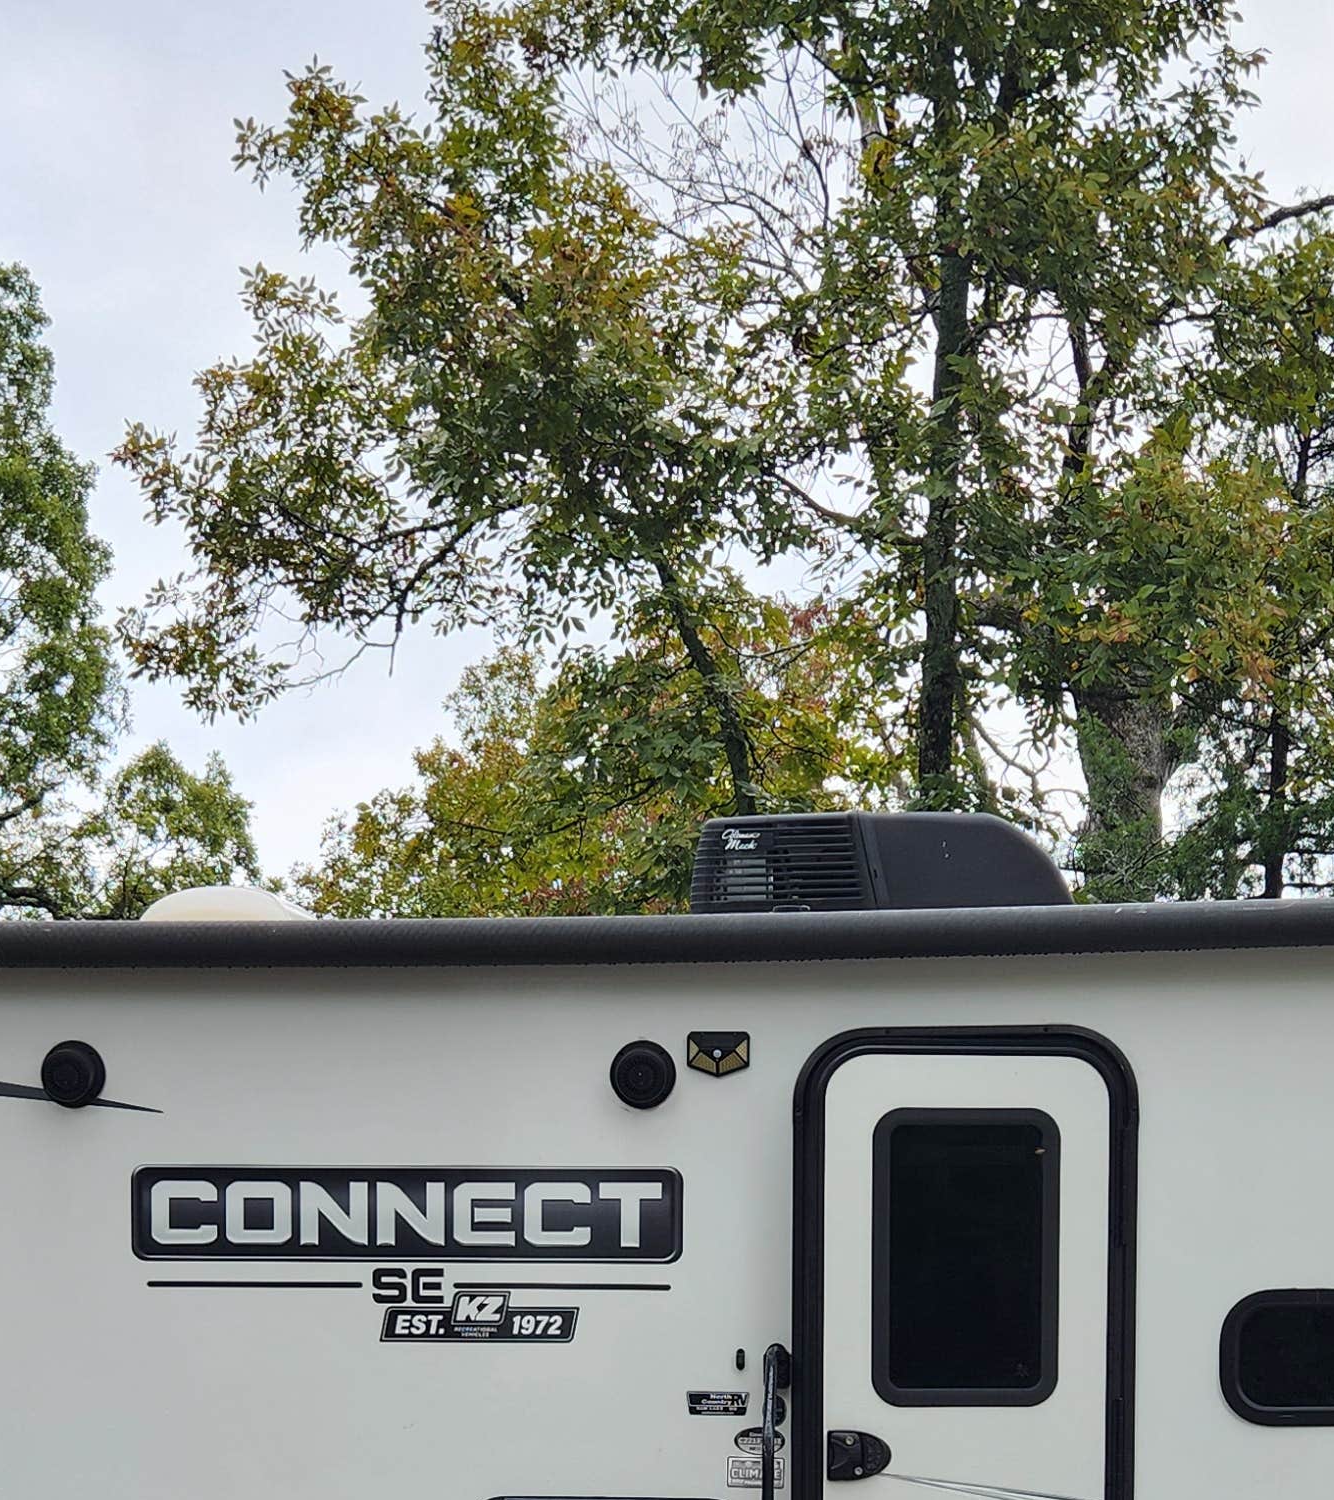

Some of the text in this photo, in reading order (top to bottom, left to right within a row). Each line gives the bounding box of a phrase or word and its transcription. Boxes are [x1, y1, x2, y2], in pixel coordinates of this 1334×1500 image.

[150, 1180, 663, 1248] CONNECT
[372, 1268, 445, 1304] SE
[455, 1296, 504, 1322] KZ
[394, 1314, 563, 1335] EST. 1972
[731, 1468, 782, 1479] CLIME
